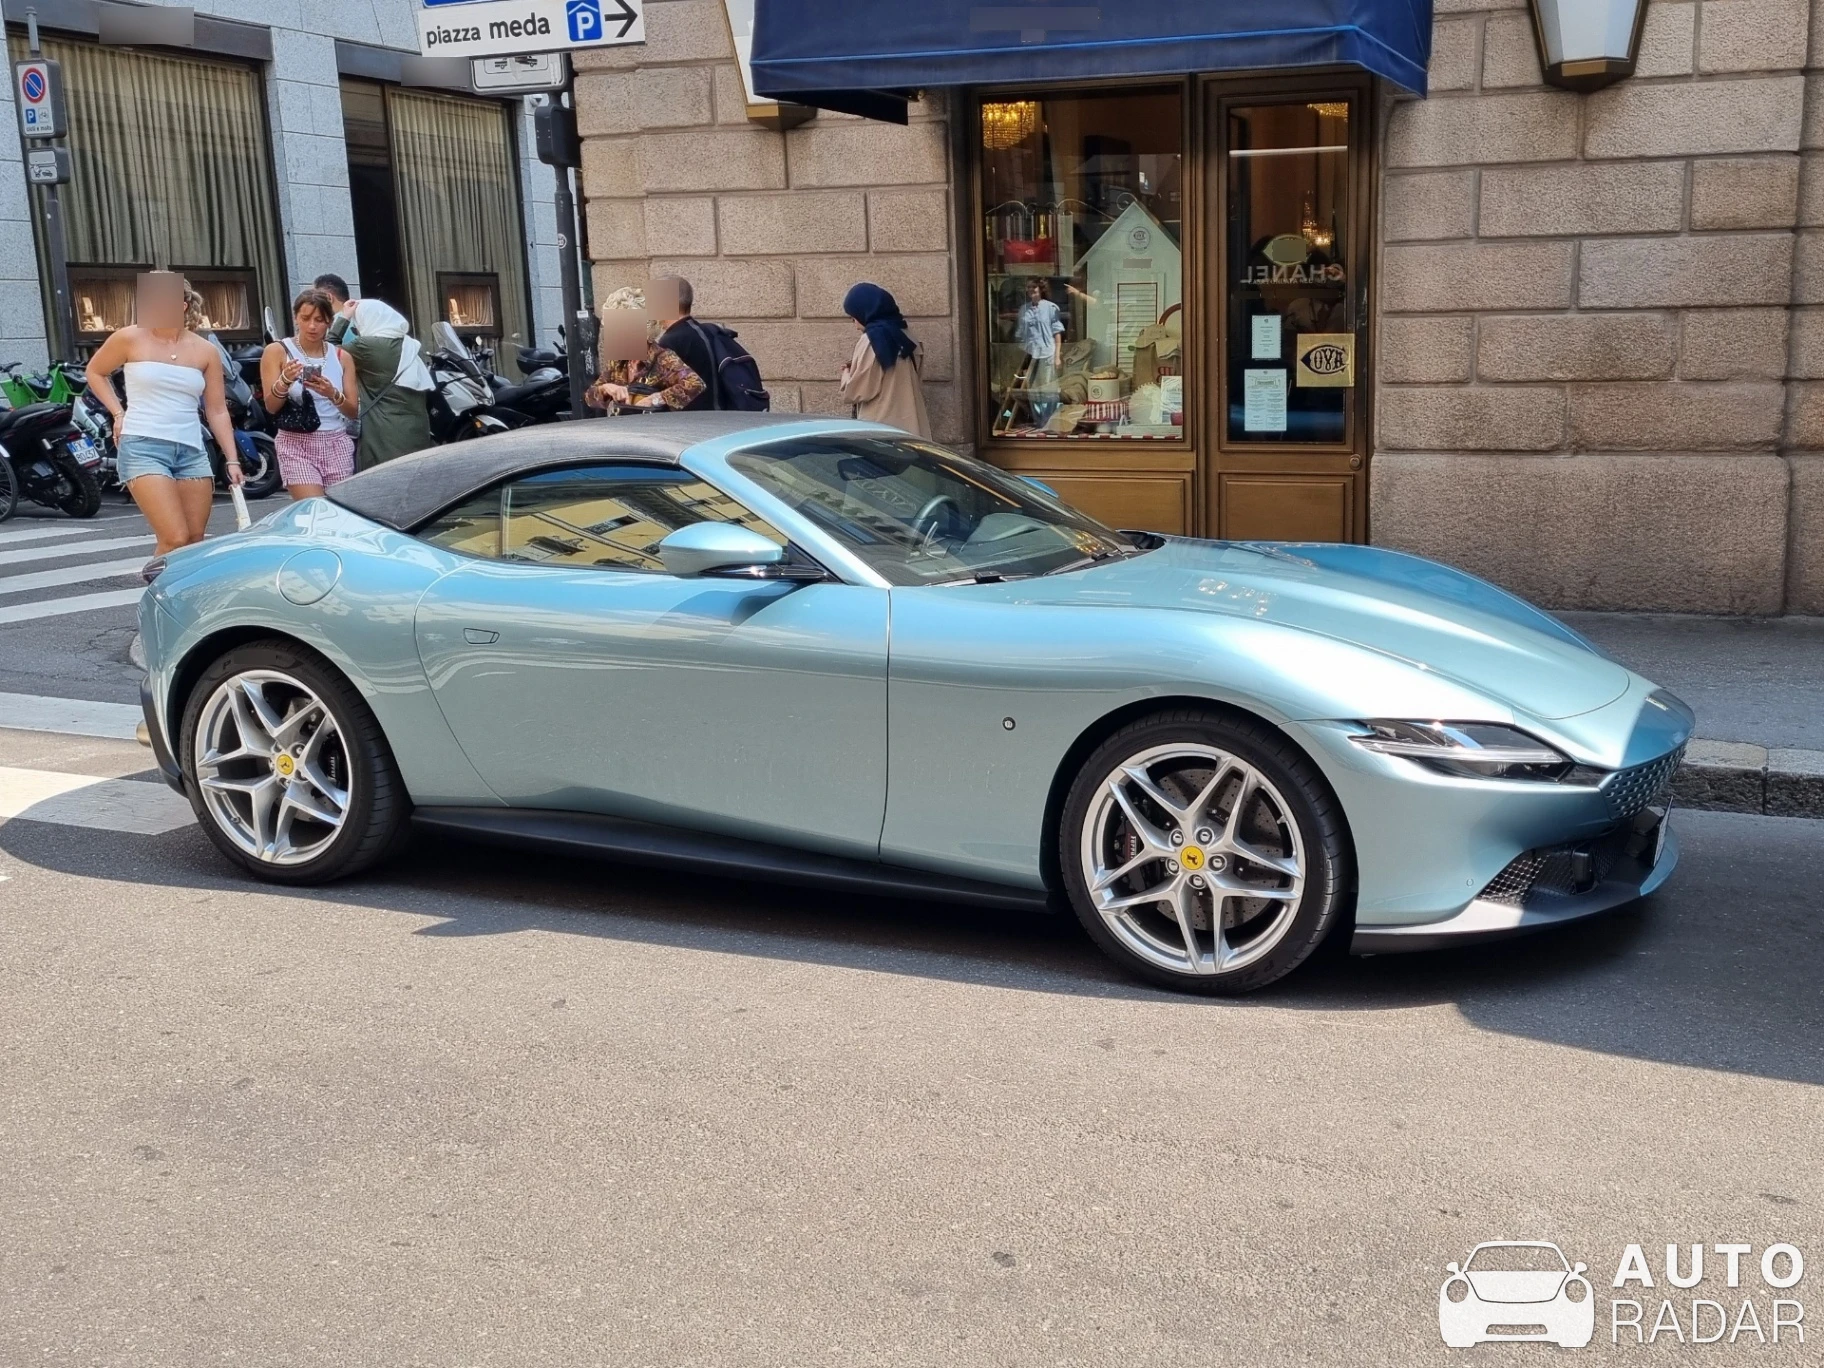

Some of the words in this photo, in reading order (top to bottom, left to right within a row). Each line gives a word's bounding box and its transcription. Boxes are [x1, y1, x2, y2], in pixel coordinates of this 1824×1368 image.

[426, 27, 481, 48] piazza
[489, 12, 551, 39] meda
[576, 11, 595, 39] P
